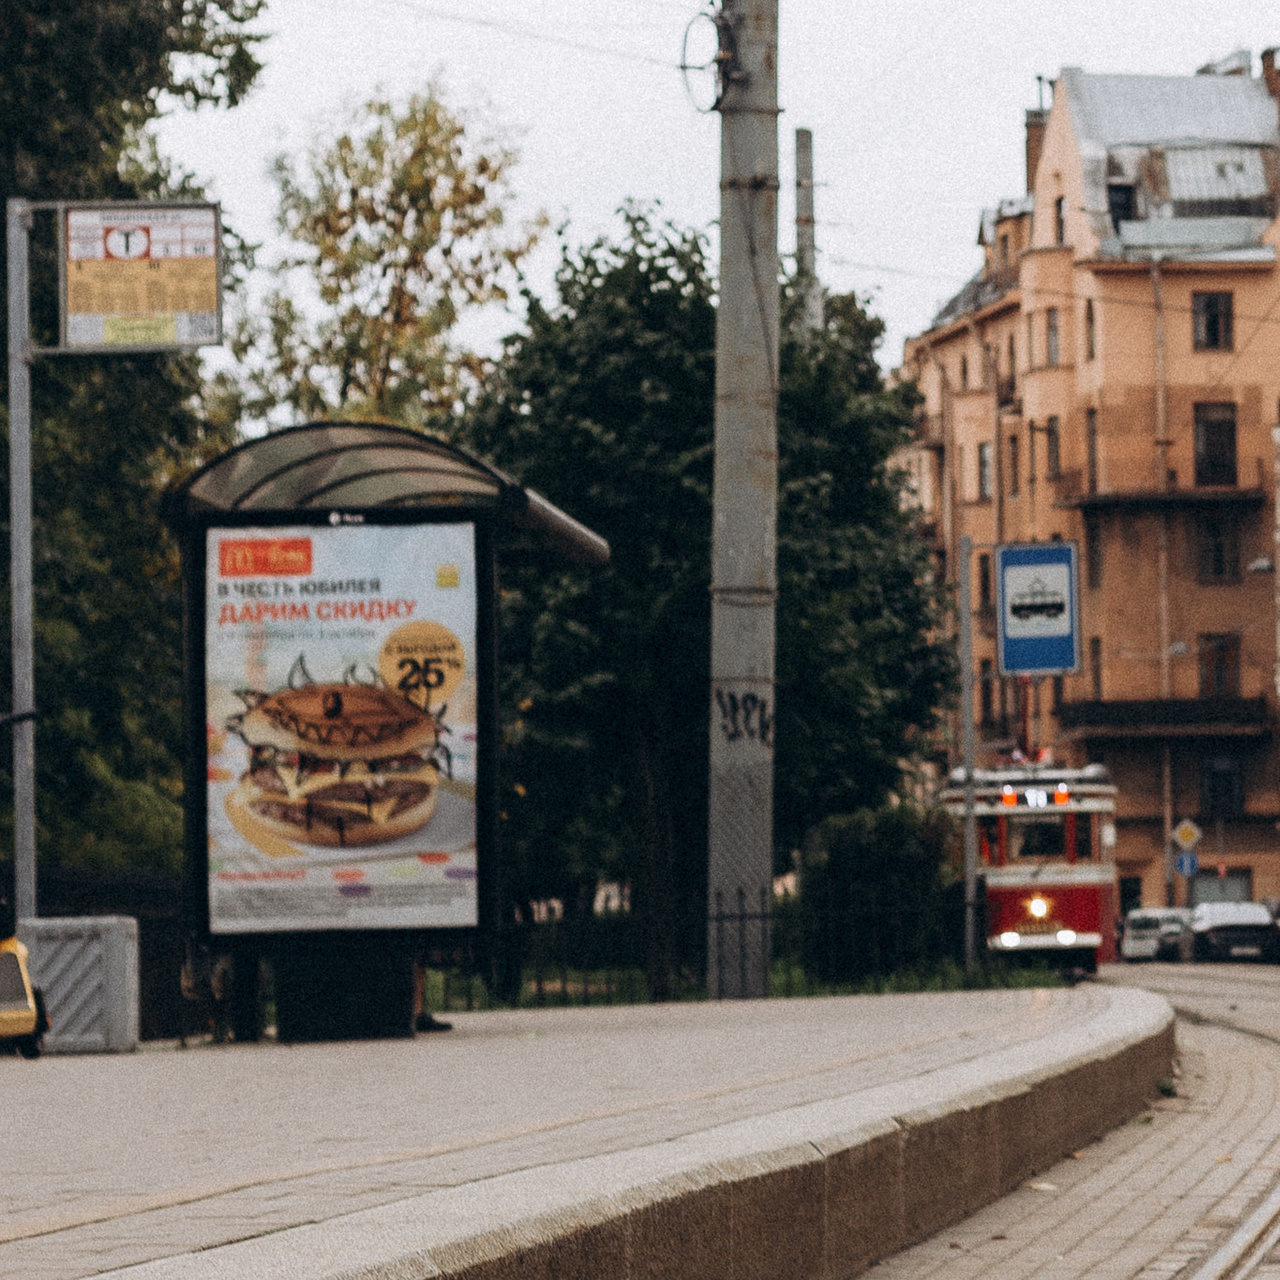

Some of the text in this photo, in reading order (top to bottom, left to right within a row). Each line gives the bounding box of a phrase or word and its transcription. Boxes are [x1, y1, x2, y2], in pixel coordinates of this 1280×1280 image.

[218, 577, 381, 597] В ЧЕСТЬ ЮБИЛЕЯ
[218, 599, 417, 626] ДАРИМ СКИДКУ
